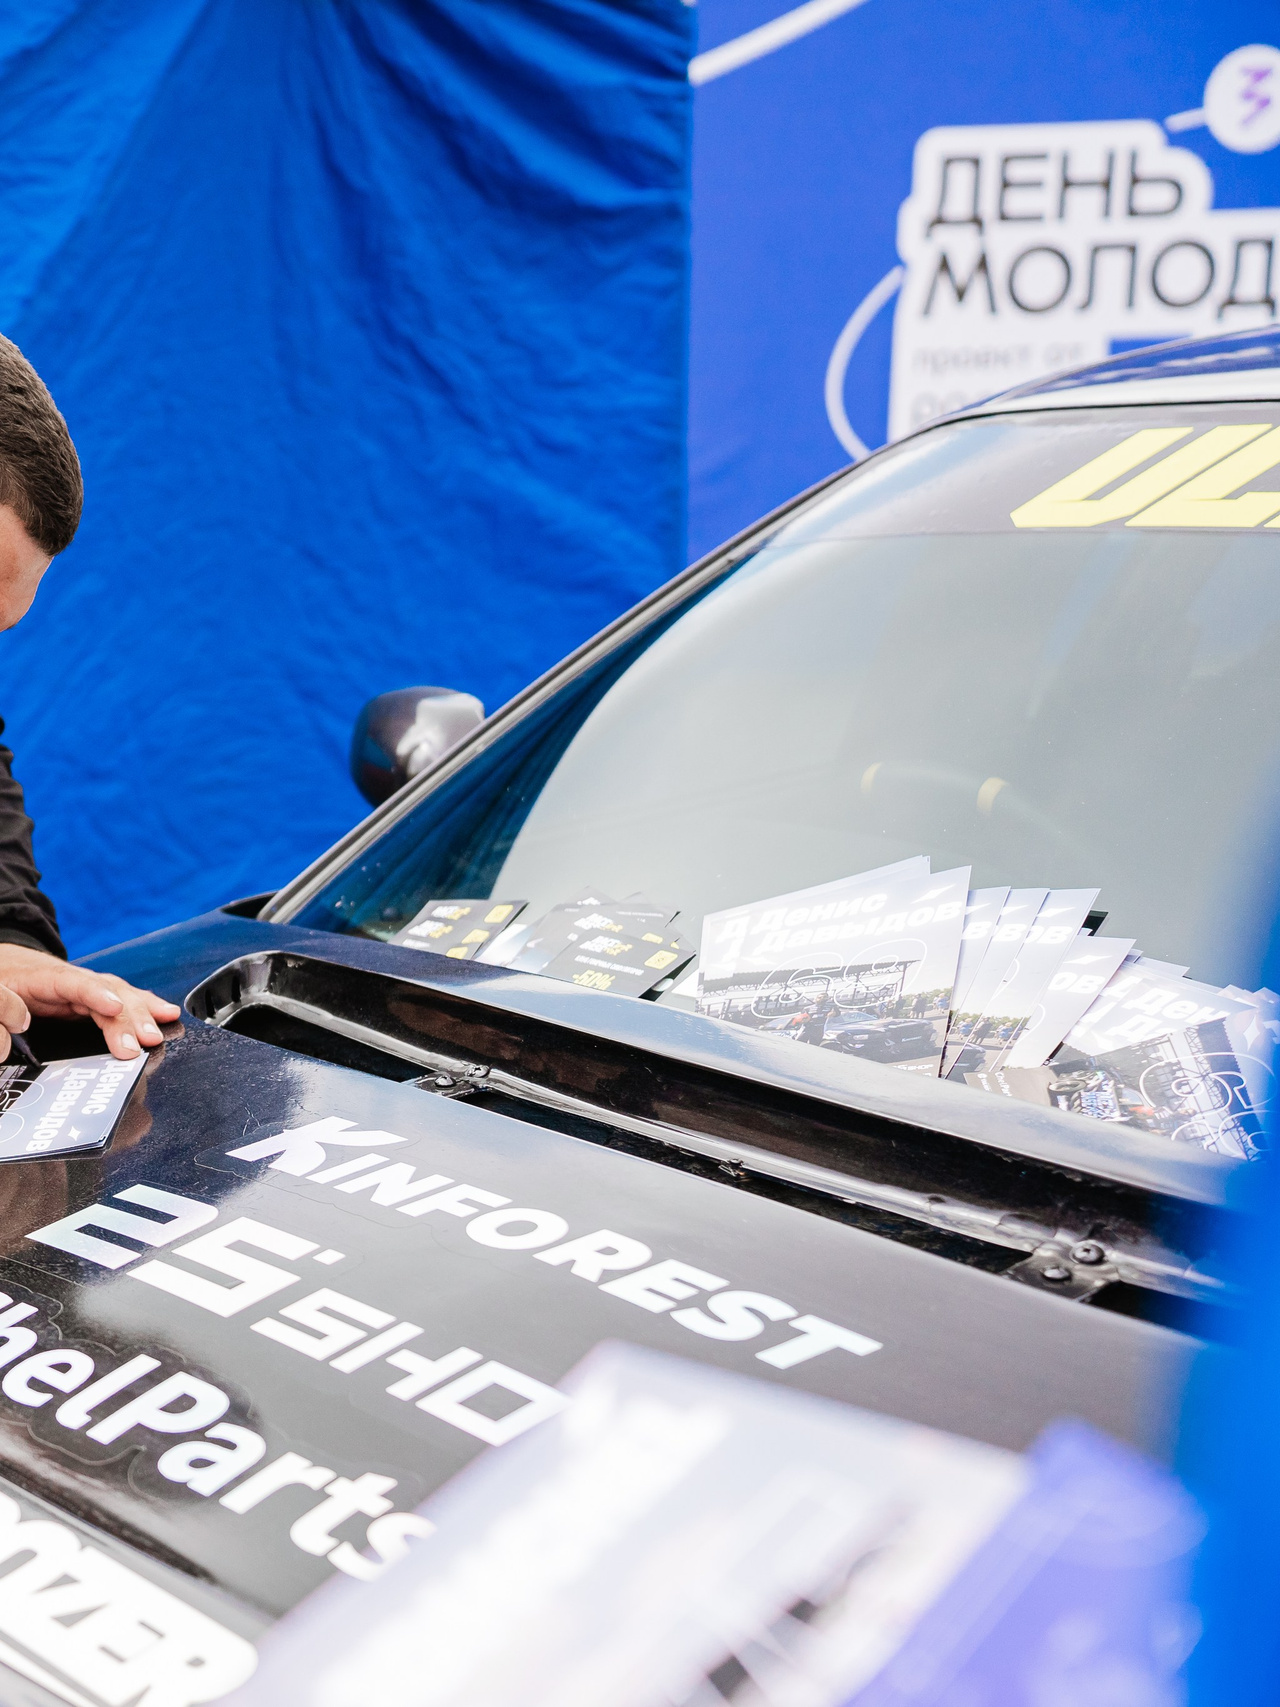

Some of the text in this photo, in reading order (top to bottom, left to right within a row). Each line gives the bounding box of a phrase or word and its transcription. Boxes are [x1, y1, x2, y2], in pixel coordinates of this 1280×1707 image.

[927, 148, 1183, 238] ДЕНЬ
[750, 893, 888, 935] Денис
[225, 1115, 884, 1370] KINFOREST
[250, 1287, 575, 1448] SHO
